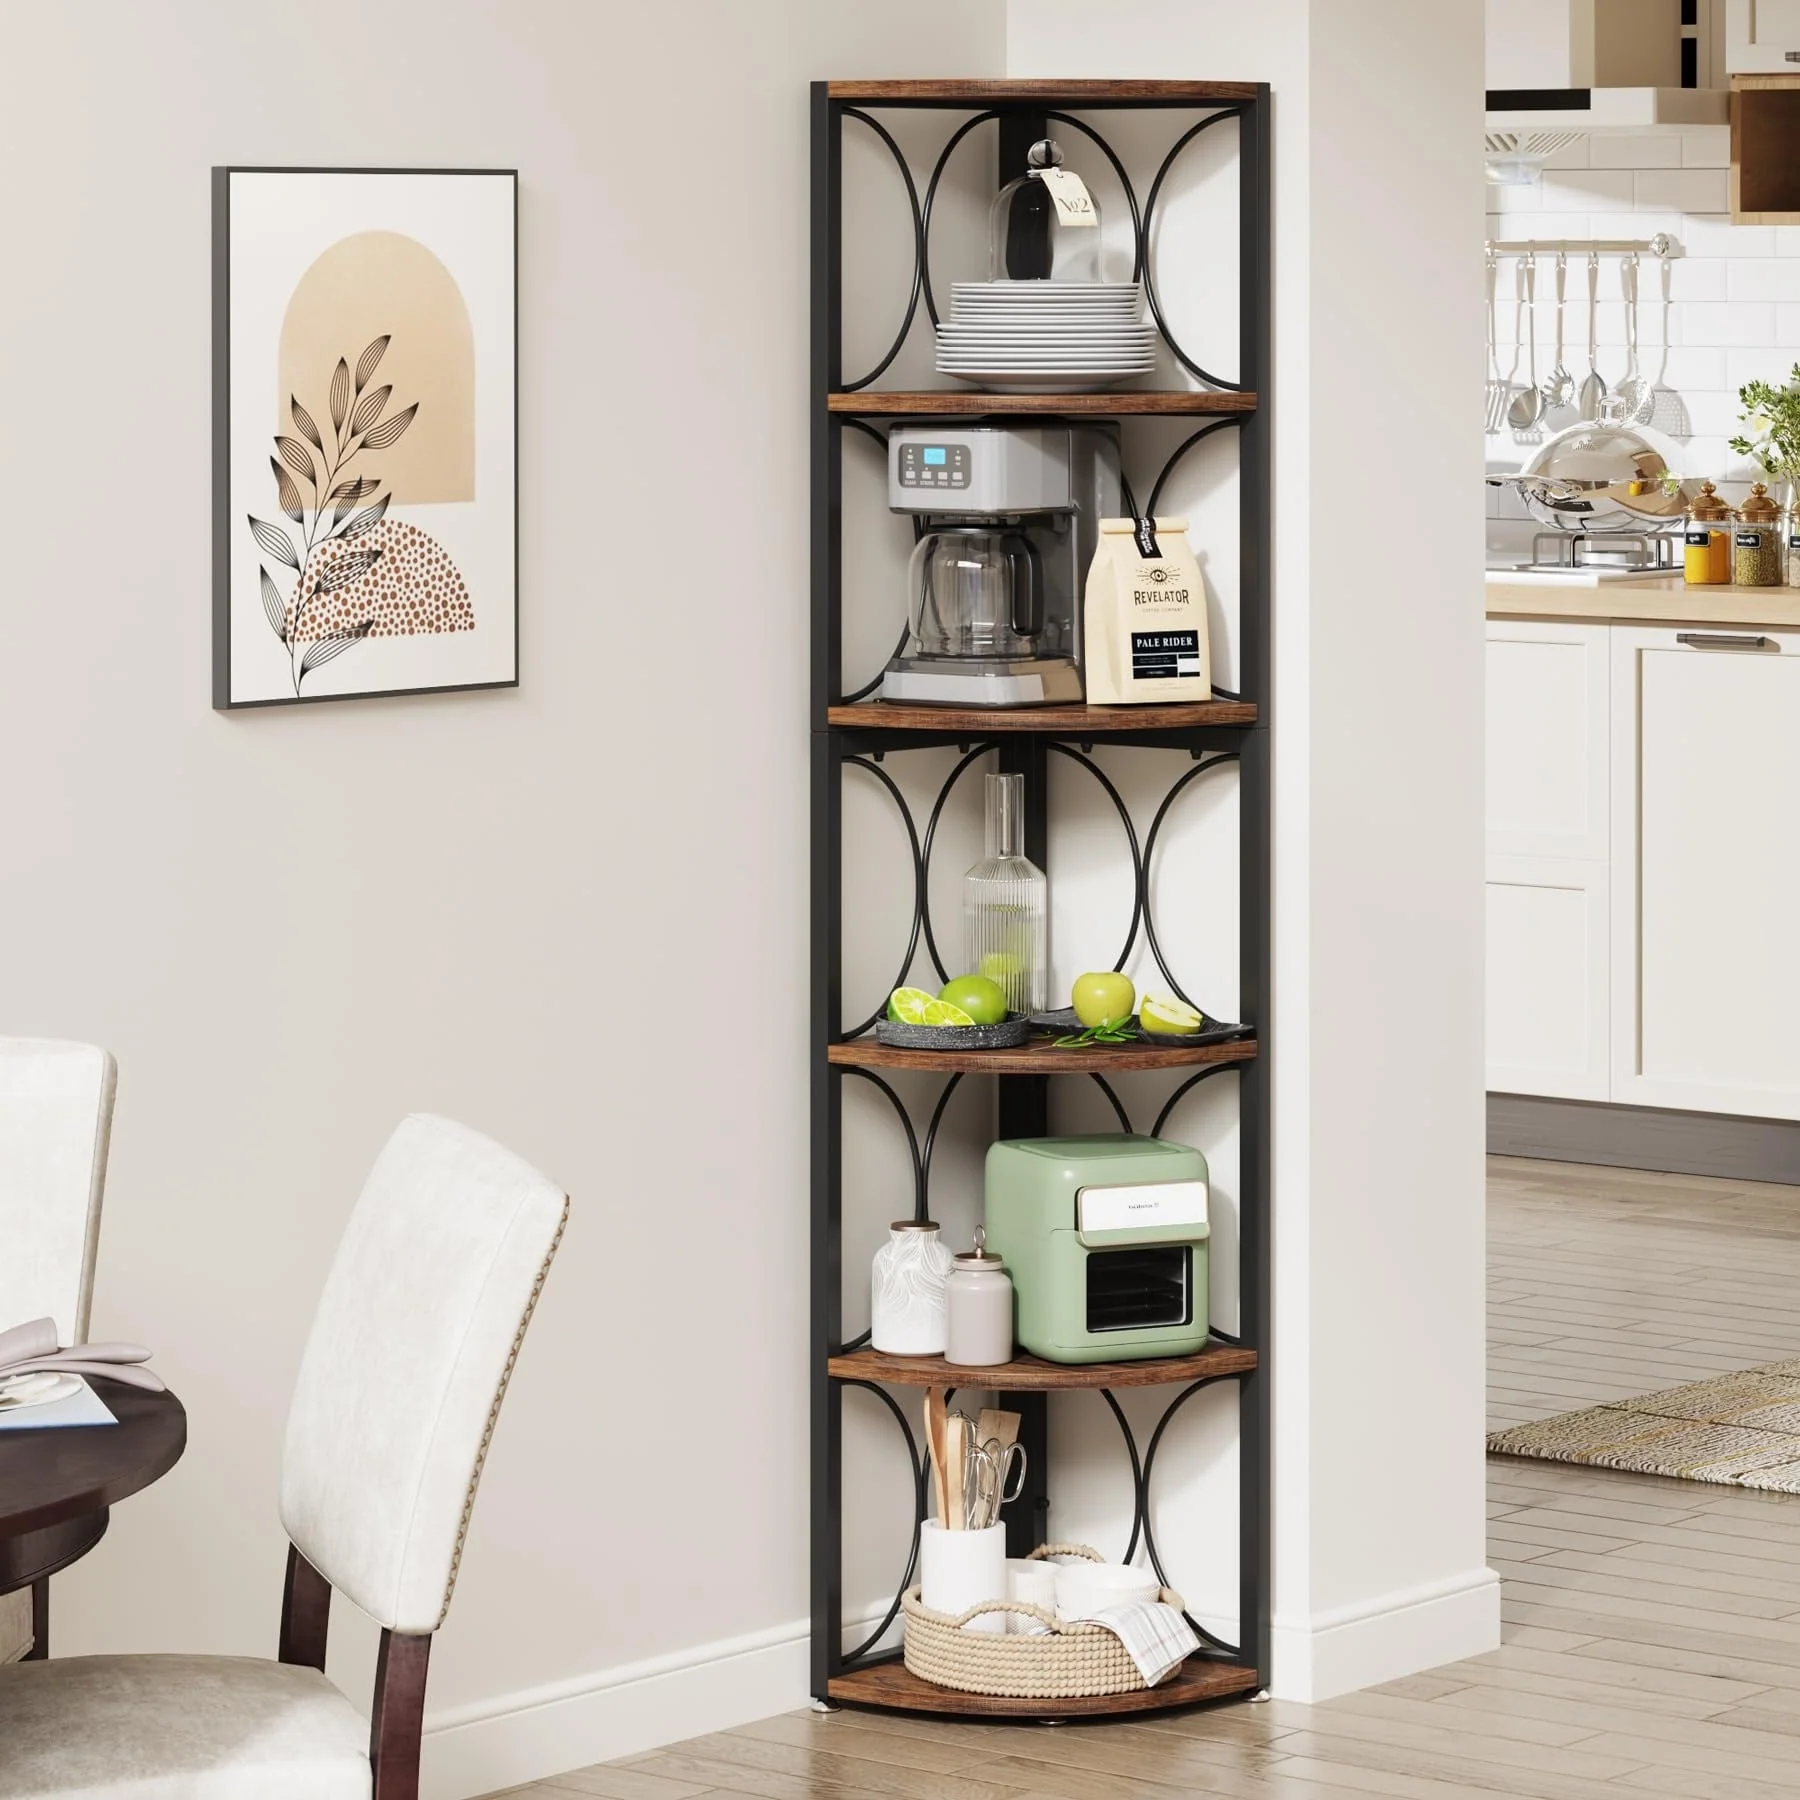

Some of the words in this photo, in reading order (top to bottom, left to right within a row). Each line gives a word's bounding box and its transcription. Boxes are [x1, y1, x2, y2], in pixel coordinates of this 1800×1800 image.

[1133, 589, 1190, 606] REVELATOR
[1136, 638, 1161, 648] PALE
[1162, 636, 1193, 647] RIDER
